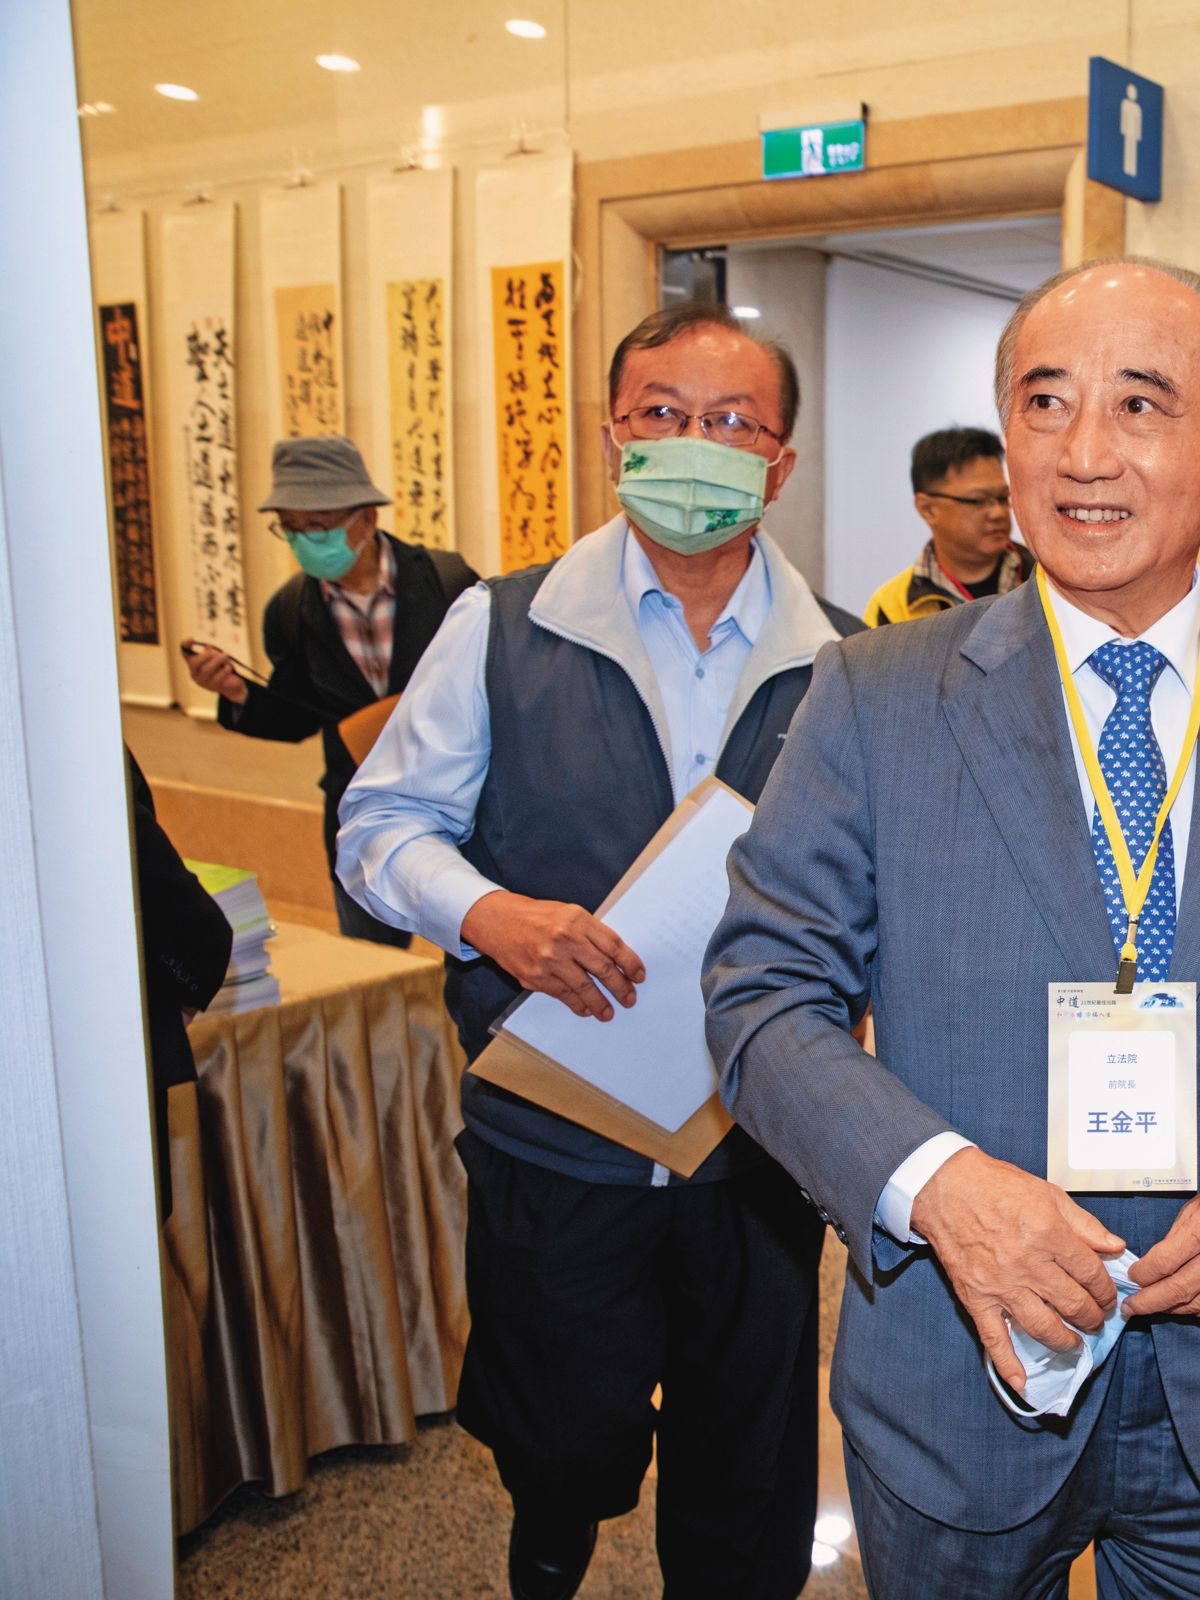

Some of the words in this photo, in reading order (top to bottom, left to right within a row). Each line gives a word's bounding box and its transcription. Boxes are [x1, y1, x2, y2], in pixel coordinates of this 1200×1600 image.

[1106, 1053, 1138, 1065] 立法院
[1108, 1079, 1137, 1090] 前院長
[1086, 1110, 1158, 1134] 王金平
